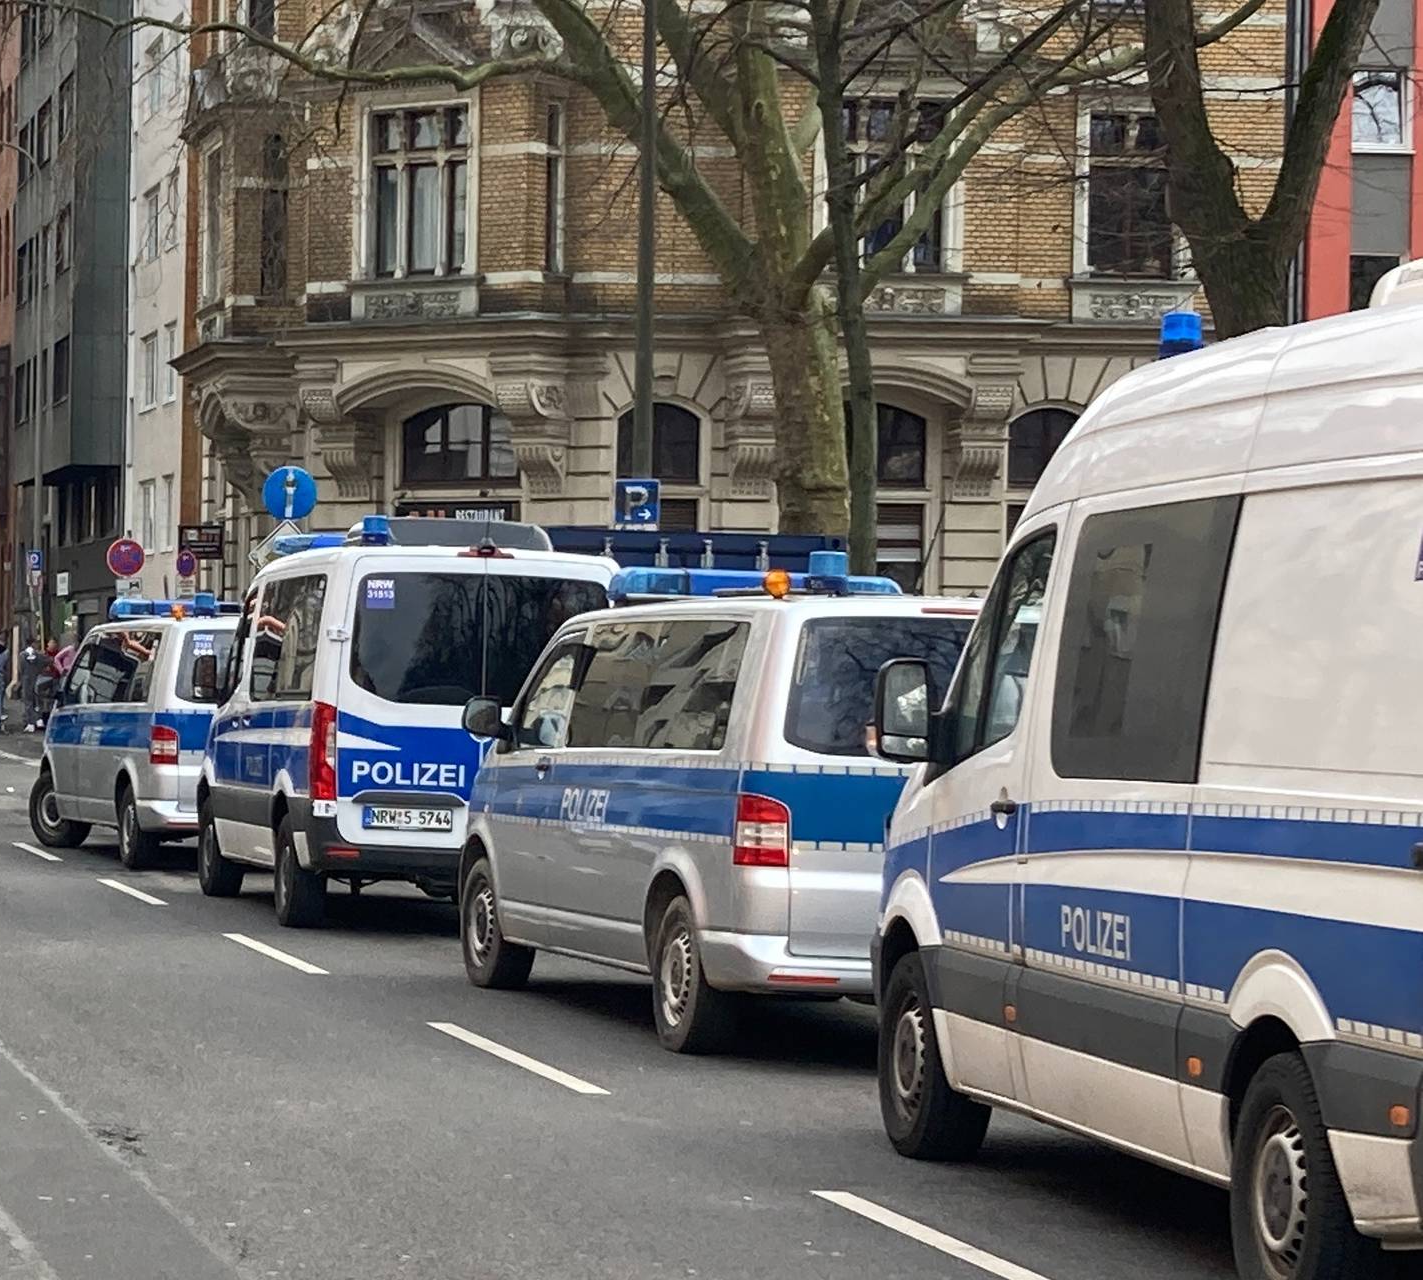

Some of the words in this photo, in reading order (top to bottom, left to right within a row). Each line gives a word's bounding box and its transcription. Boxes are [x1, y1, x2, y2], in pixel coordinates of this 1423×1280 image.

[625, 486, 648, 520] P
[367, 580, 394, 589] NRW
[352, 760, 465, 788] POLIZEI
[371, 809, 397, 825] NRW
[559, 787, 611, 823] POLIZEI
[1060, 904, 1131, 961] POLIZEI
